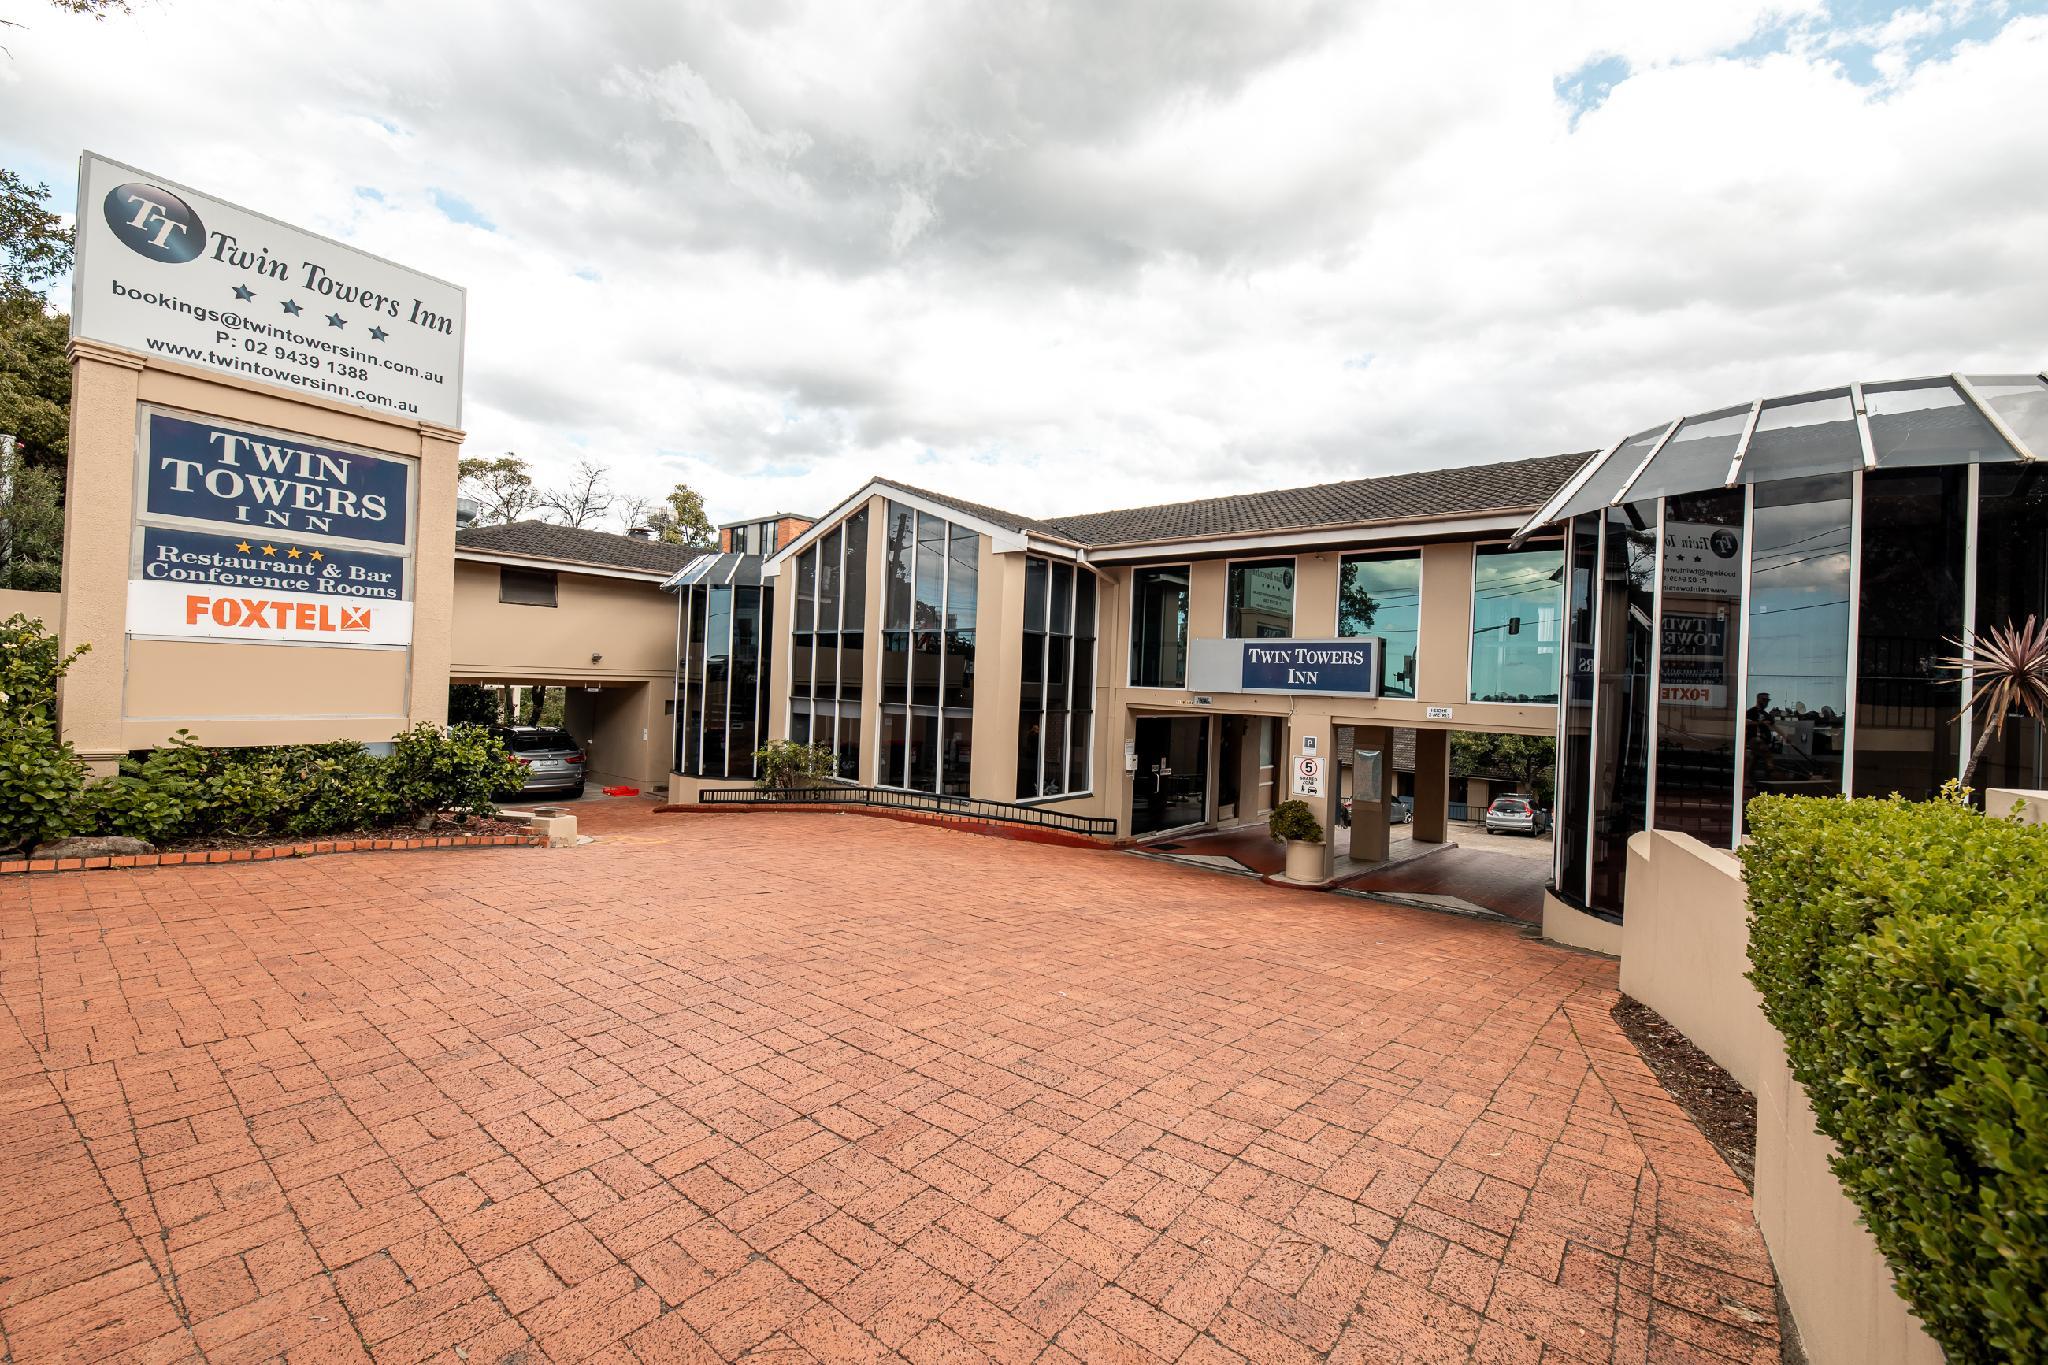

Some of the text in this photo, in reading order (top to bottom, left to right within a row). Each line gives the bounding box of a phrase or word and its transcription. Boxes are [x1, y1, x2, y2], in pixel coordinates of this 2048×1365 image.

[127, 194, 188, 249] TT
[210, 231, 453, 335] Twin Towers Inn
[112, 280, 444, 384] bookings@twintowersinn.com.au
[146, 338, 418, 414] www.twintowersinn.com.au
[216, 331, 369, 381] P: 02 9439 1388
[209, 432, 351, 484] TWIN
[161, 457, 387, 521] TOWERS
[235, 505, 332, 533] INN
[146, 562, 397, 599] Conference Rooms
[156, 545, 392, 584] Restaurant & Bar
[186, 595, 337, 632] FOXTEL
[1248, 648, 1364, 665] TWIN TOWERS
[1287, 668, 1319, 684] INN
[1305, 761, 1313, 773] 5
